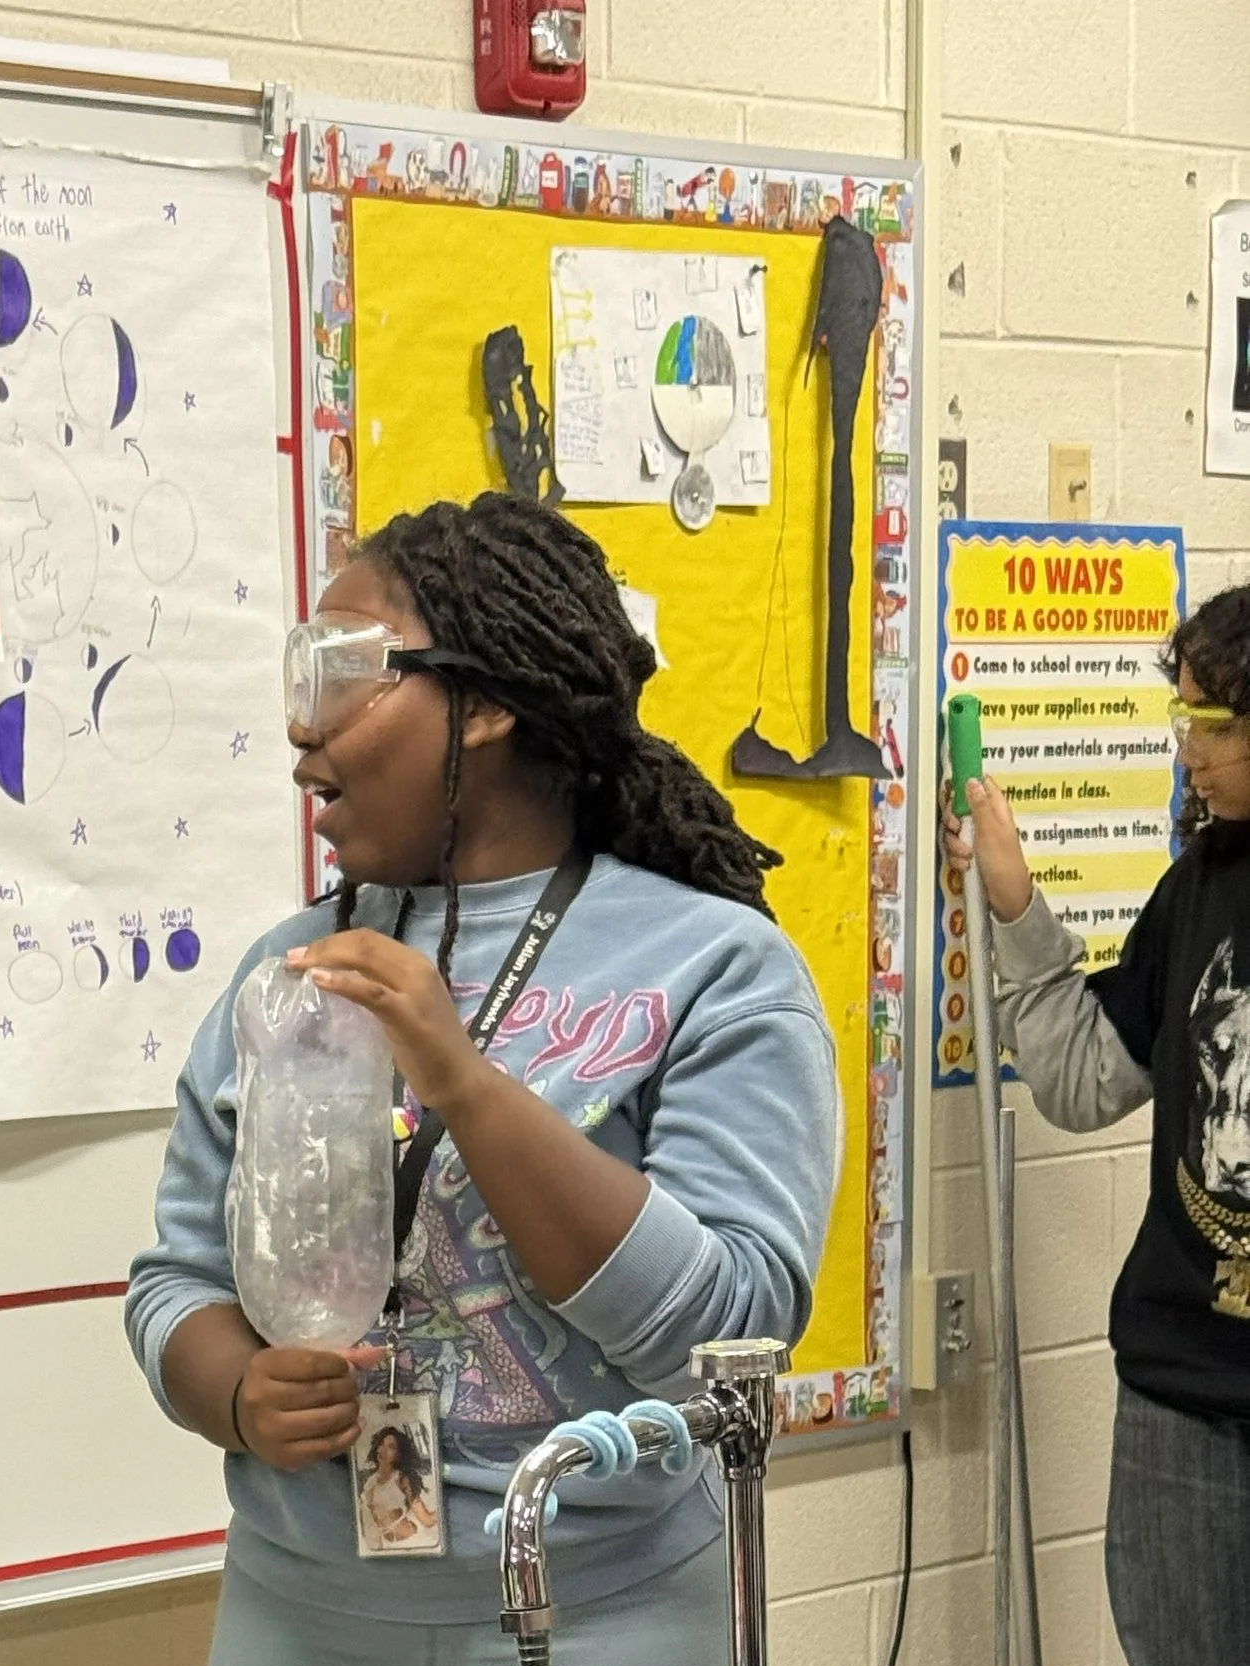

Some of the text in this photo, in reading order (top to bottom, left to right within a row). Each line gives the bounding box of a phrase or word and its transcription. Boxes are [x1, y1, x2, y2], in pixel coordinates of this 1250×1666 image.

[21, 173, 50, 205] the
[35, 214, 71, 242] earth
[1003, 556, 1123, 596] 10 WAYS
[954, 608, 1169, 632] TO BE A GOOD STUDENT
[973, 655, 1008, 675] Come
[1013, 657, 1025, 675] to
[1030, 654, 1071, 674] school
[1075, 659, 1111, 678] every
[1115, 654, 1142, 679] day.
[1010, 701, 1040, 721] your
[1044, 698, 1096, 721] supplies
[1099, 696, 1139, 718] ready.
[981, 737, 1172, 763] ave your materials organized.
[1002, 780, 1111, 801] ttention in class.
[1033, 822, 1109, 845] assignments
[1113, 826, 1128, 838] on
[1132, 820, 1163, 837] time.
[1093, 910, 1114, 926] you
[479, 933, 541, 1033] Julian Jayhawks
